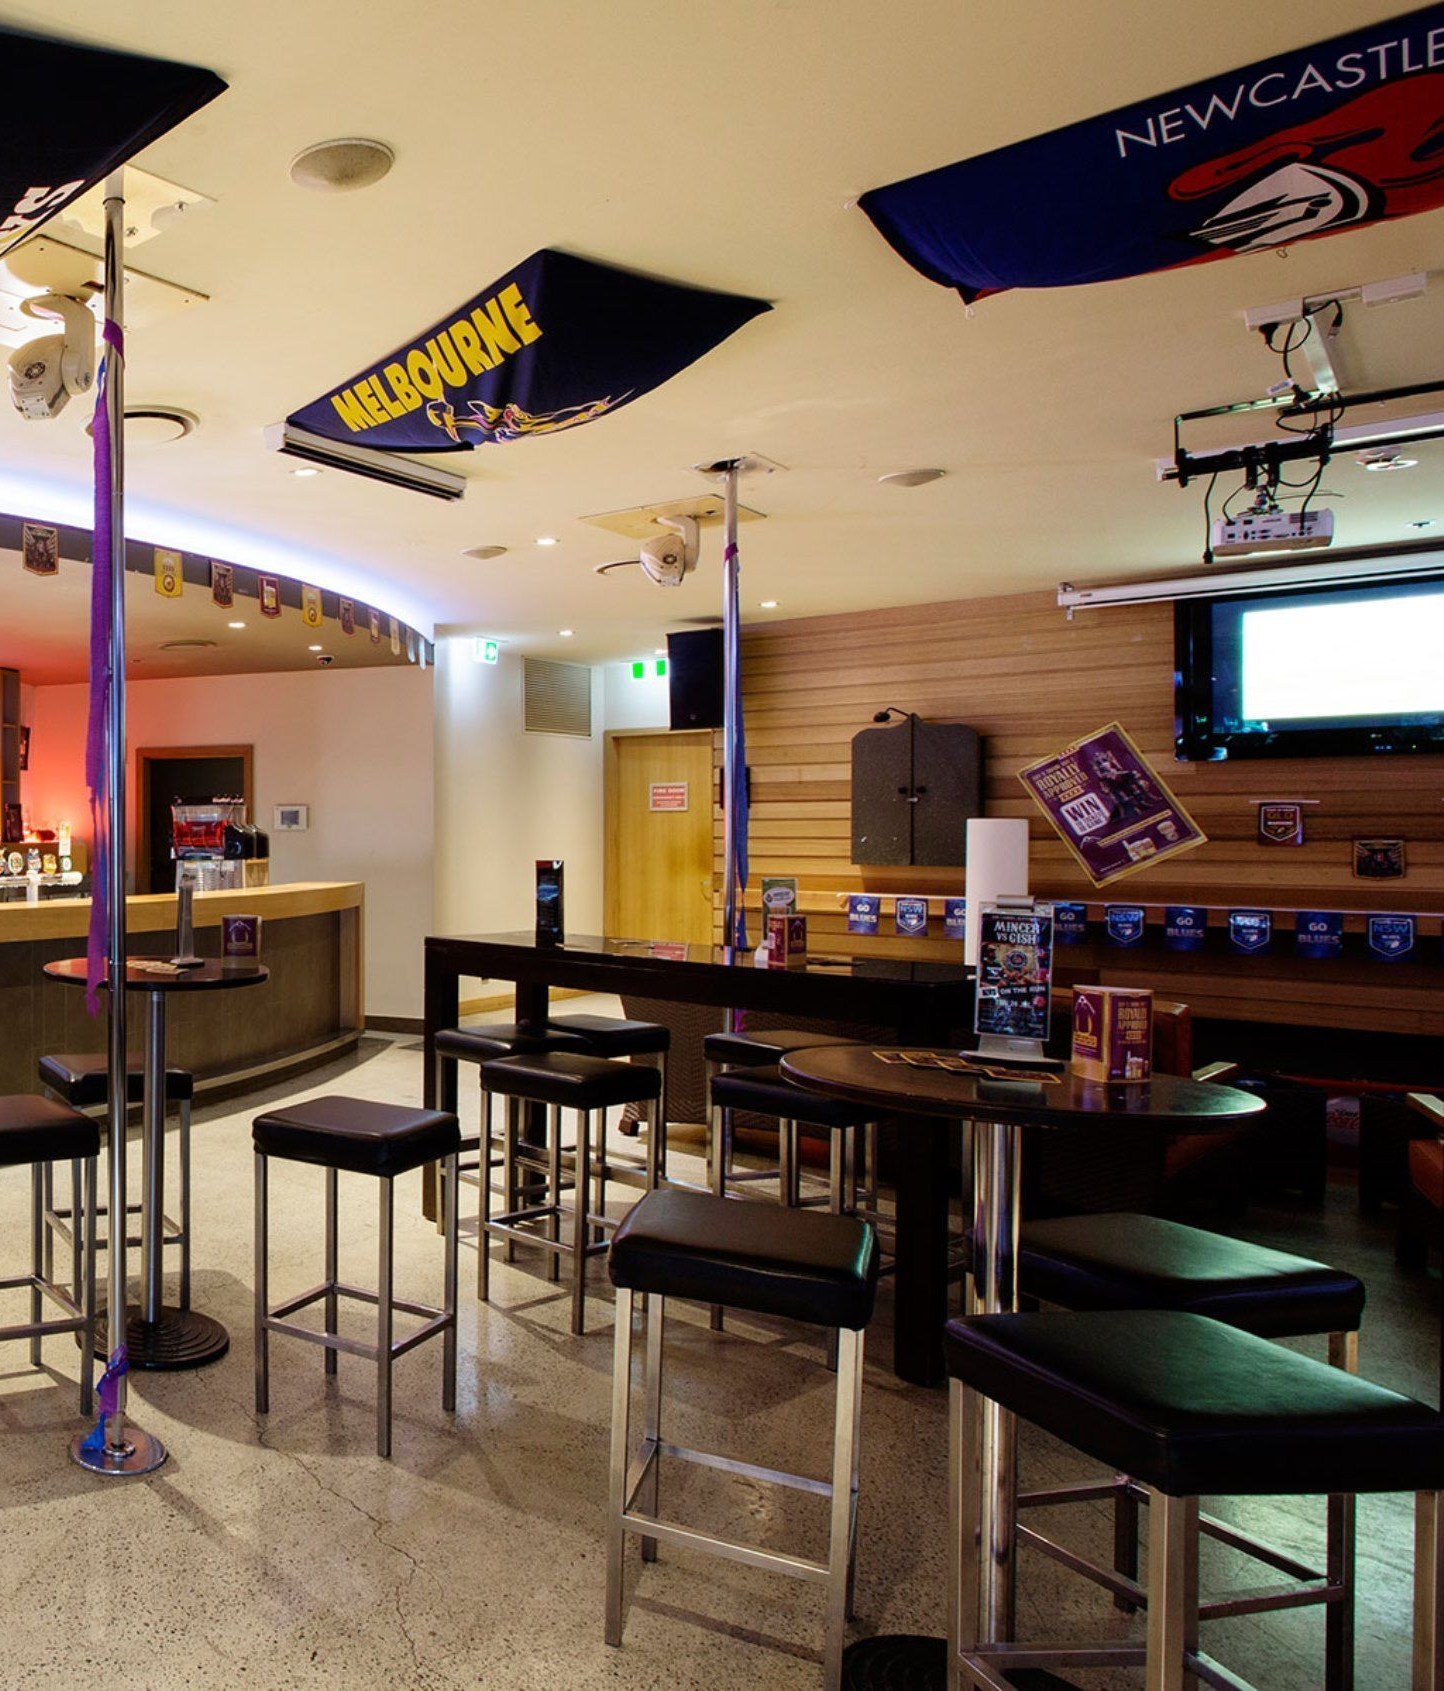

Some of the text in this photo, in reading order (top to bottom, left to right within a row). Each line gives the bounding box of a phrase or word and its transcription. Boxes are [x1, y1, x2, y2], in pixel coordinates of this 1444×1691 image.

[1115, 27, 1444, 158] NEWCASTLE
[330, 282, 543, 432] MELBOURNE
[1035, 761, 1082, 791] ROYALLY
[1065, 795, 1103, 823] WIN
[856, 904, 870, 912] GO
[900, 906, 923, 914] NSW
[849, 914, 877, 923] BLUES
[1059, 912, 1075, 921] GO
[1110, 914, 1140, 922] NSW
[946, 918, 966, 926] BLU
[1176, 917, 1194, 926] GO
[994, 921, 1040, 934] MINCER
[1308, 922, 1328, 932] GO
[1374, 924, 1408, 933] NSW
[996, 932, 1008, 941] VS
[1167, 928, 1204, 938] BLUES
[1298, 935, 1340, 944] BLUES
